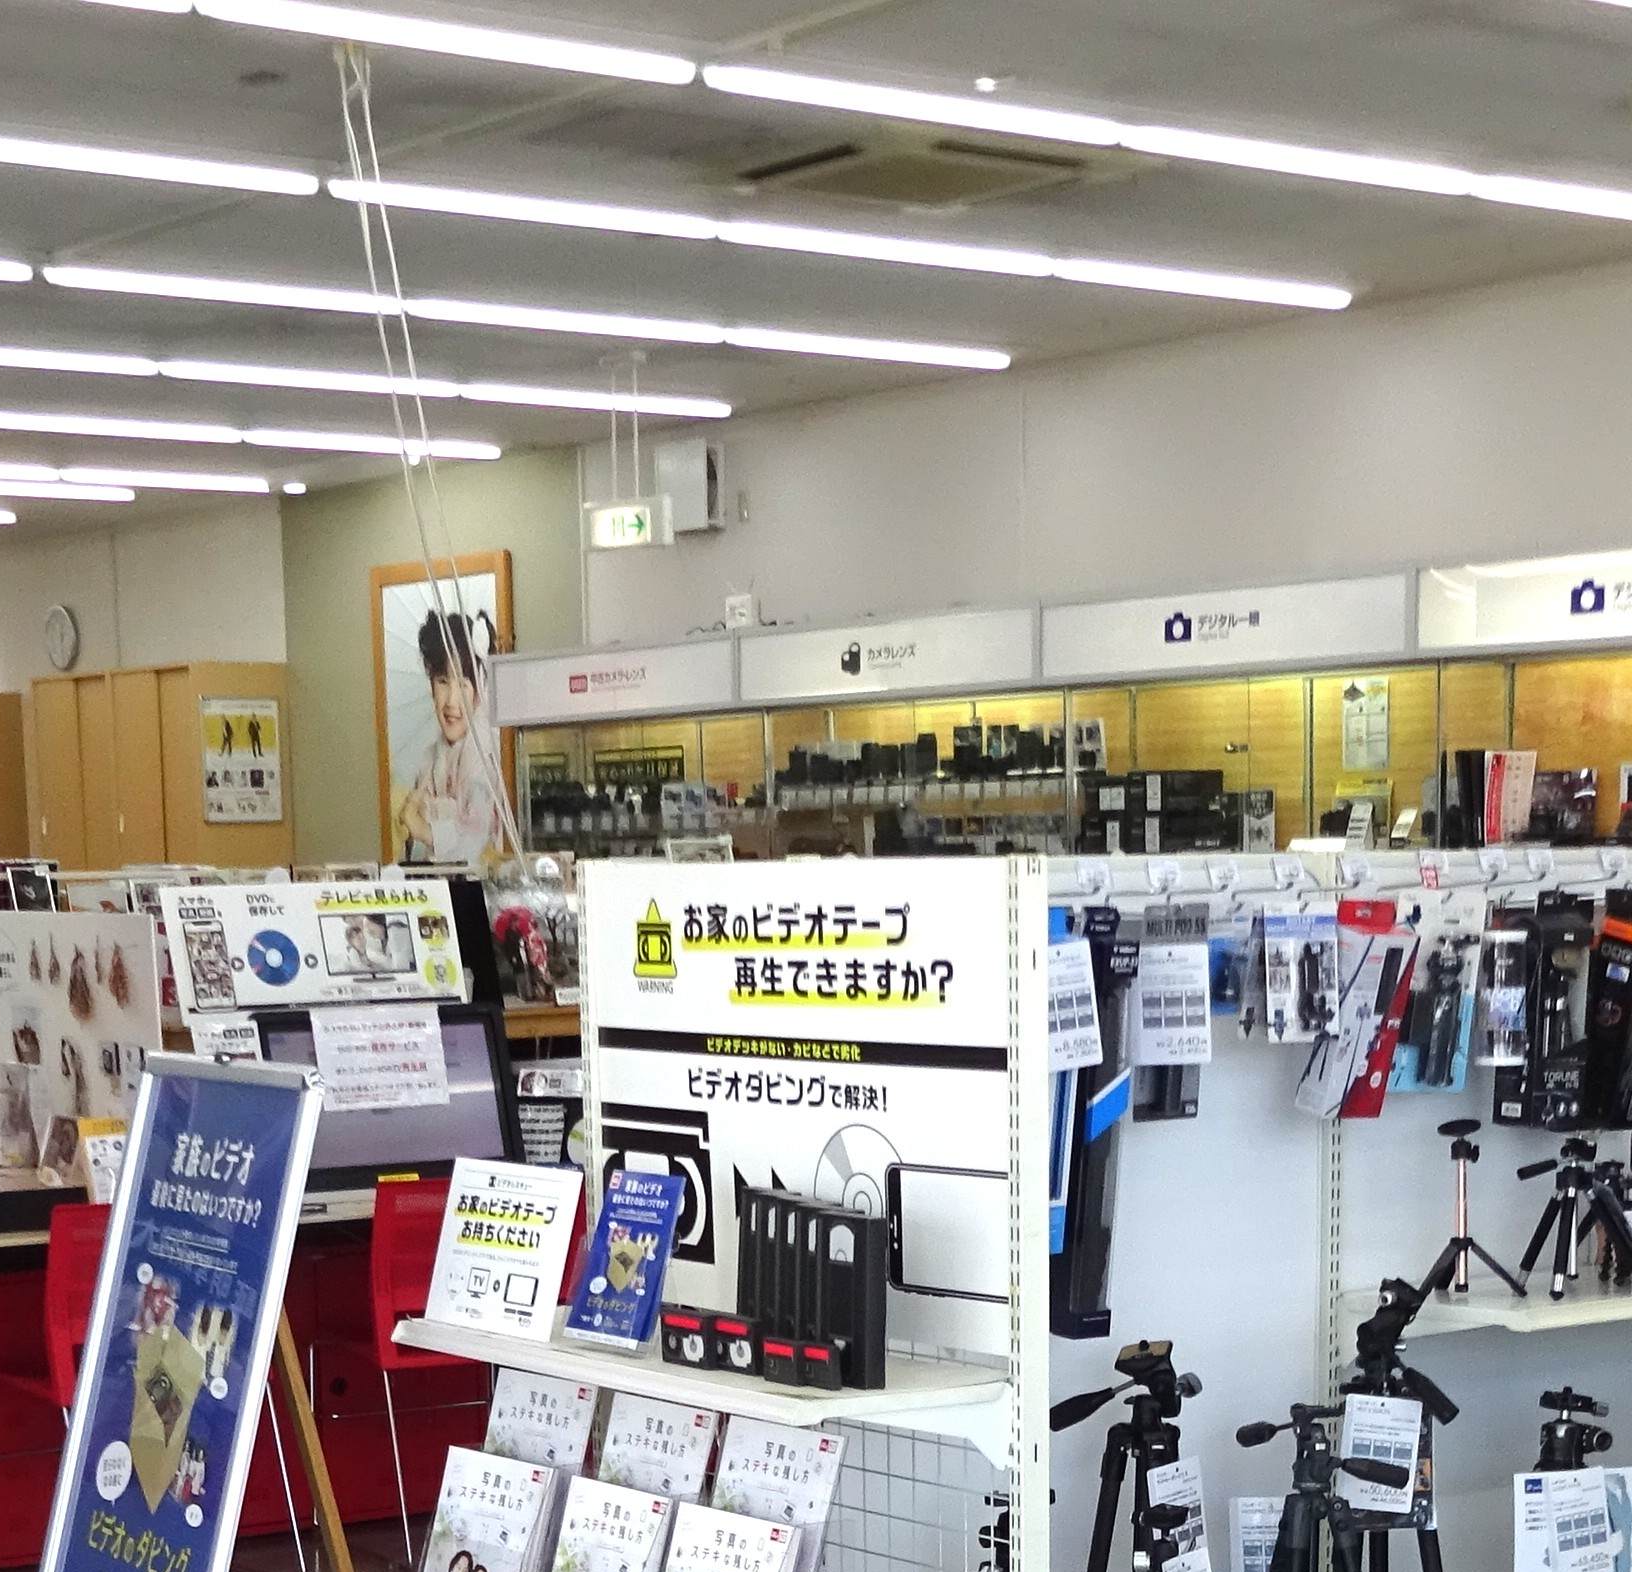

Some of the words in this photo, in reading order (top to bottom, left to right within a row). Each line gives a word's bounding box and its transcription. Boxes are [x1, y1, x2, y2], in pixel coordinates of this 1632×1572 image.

[320, 887, 429, 906] テレビで見られる
[682, 902, 911, 947] お家のビデオテープ
[734, 956, 955, 1003] 再生できますか?
[171, 1131, 256, 1187] 家族のビデオ
[456, 1194, 558, 1225] お家のビデオテープ
[460, 1219, 542, 1249] お持ちください
[530, 1390, 560, 1410] 写真の
[508, 1406, 572, 1431] ステキな残し方
[644, 1416, 675, 1438] 写真の
[622, 1431, 687, 1459] ステキな残し方
[764, 1439, 798, 1462] 写真の
[480, 1470, 513, 1493] 写真の
[740, 1456, 812, 1485] ステキな残し方
[458, 1485, 525, 1512] ステキな残し方
[601, 1500, 633, 1524] 写真の
[580, 1516, 645, 1545] ステキな残し方
[713, 1529, 748, 1551] 写真の
